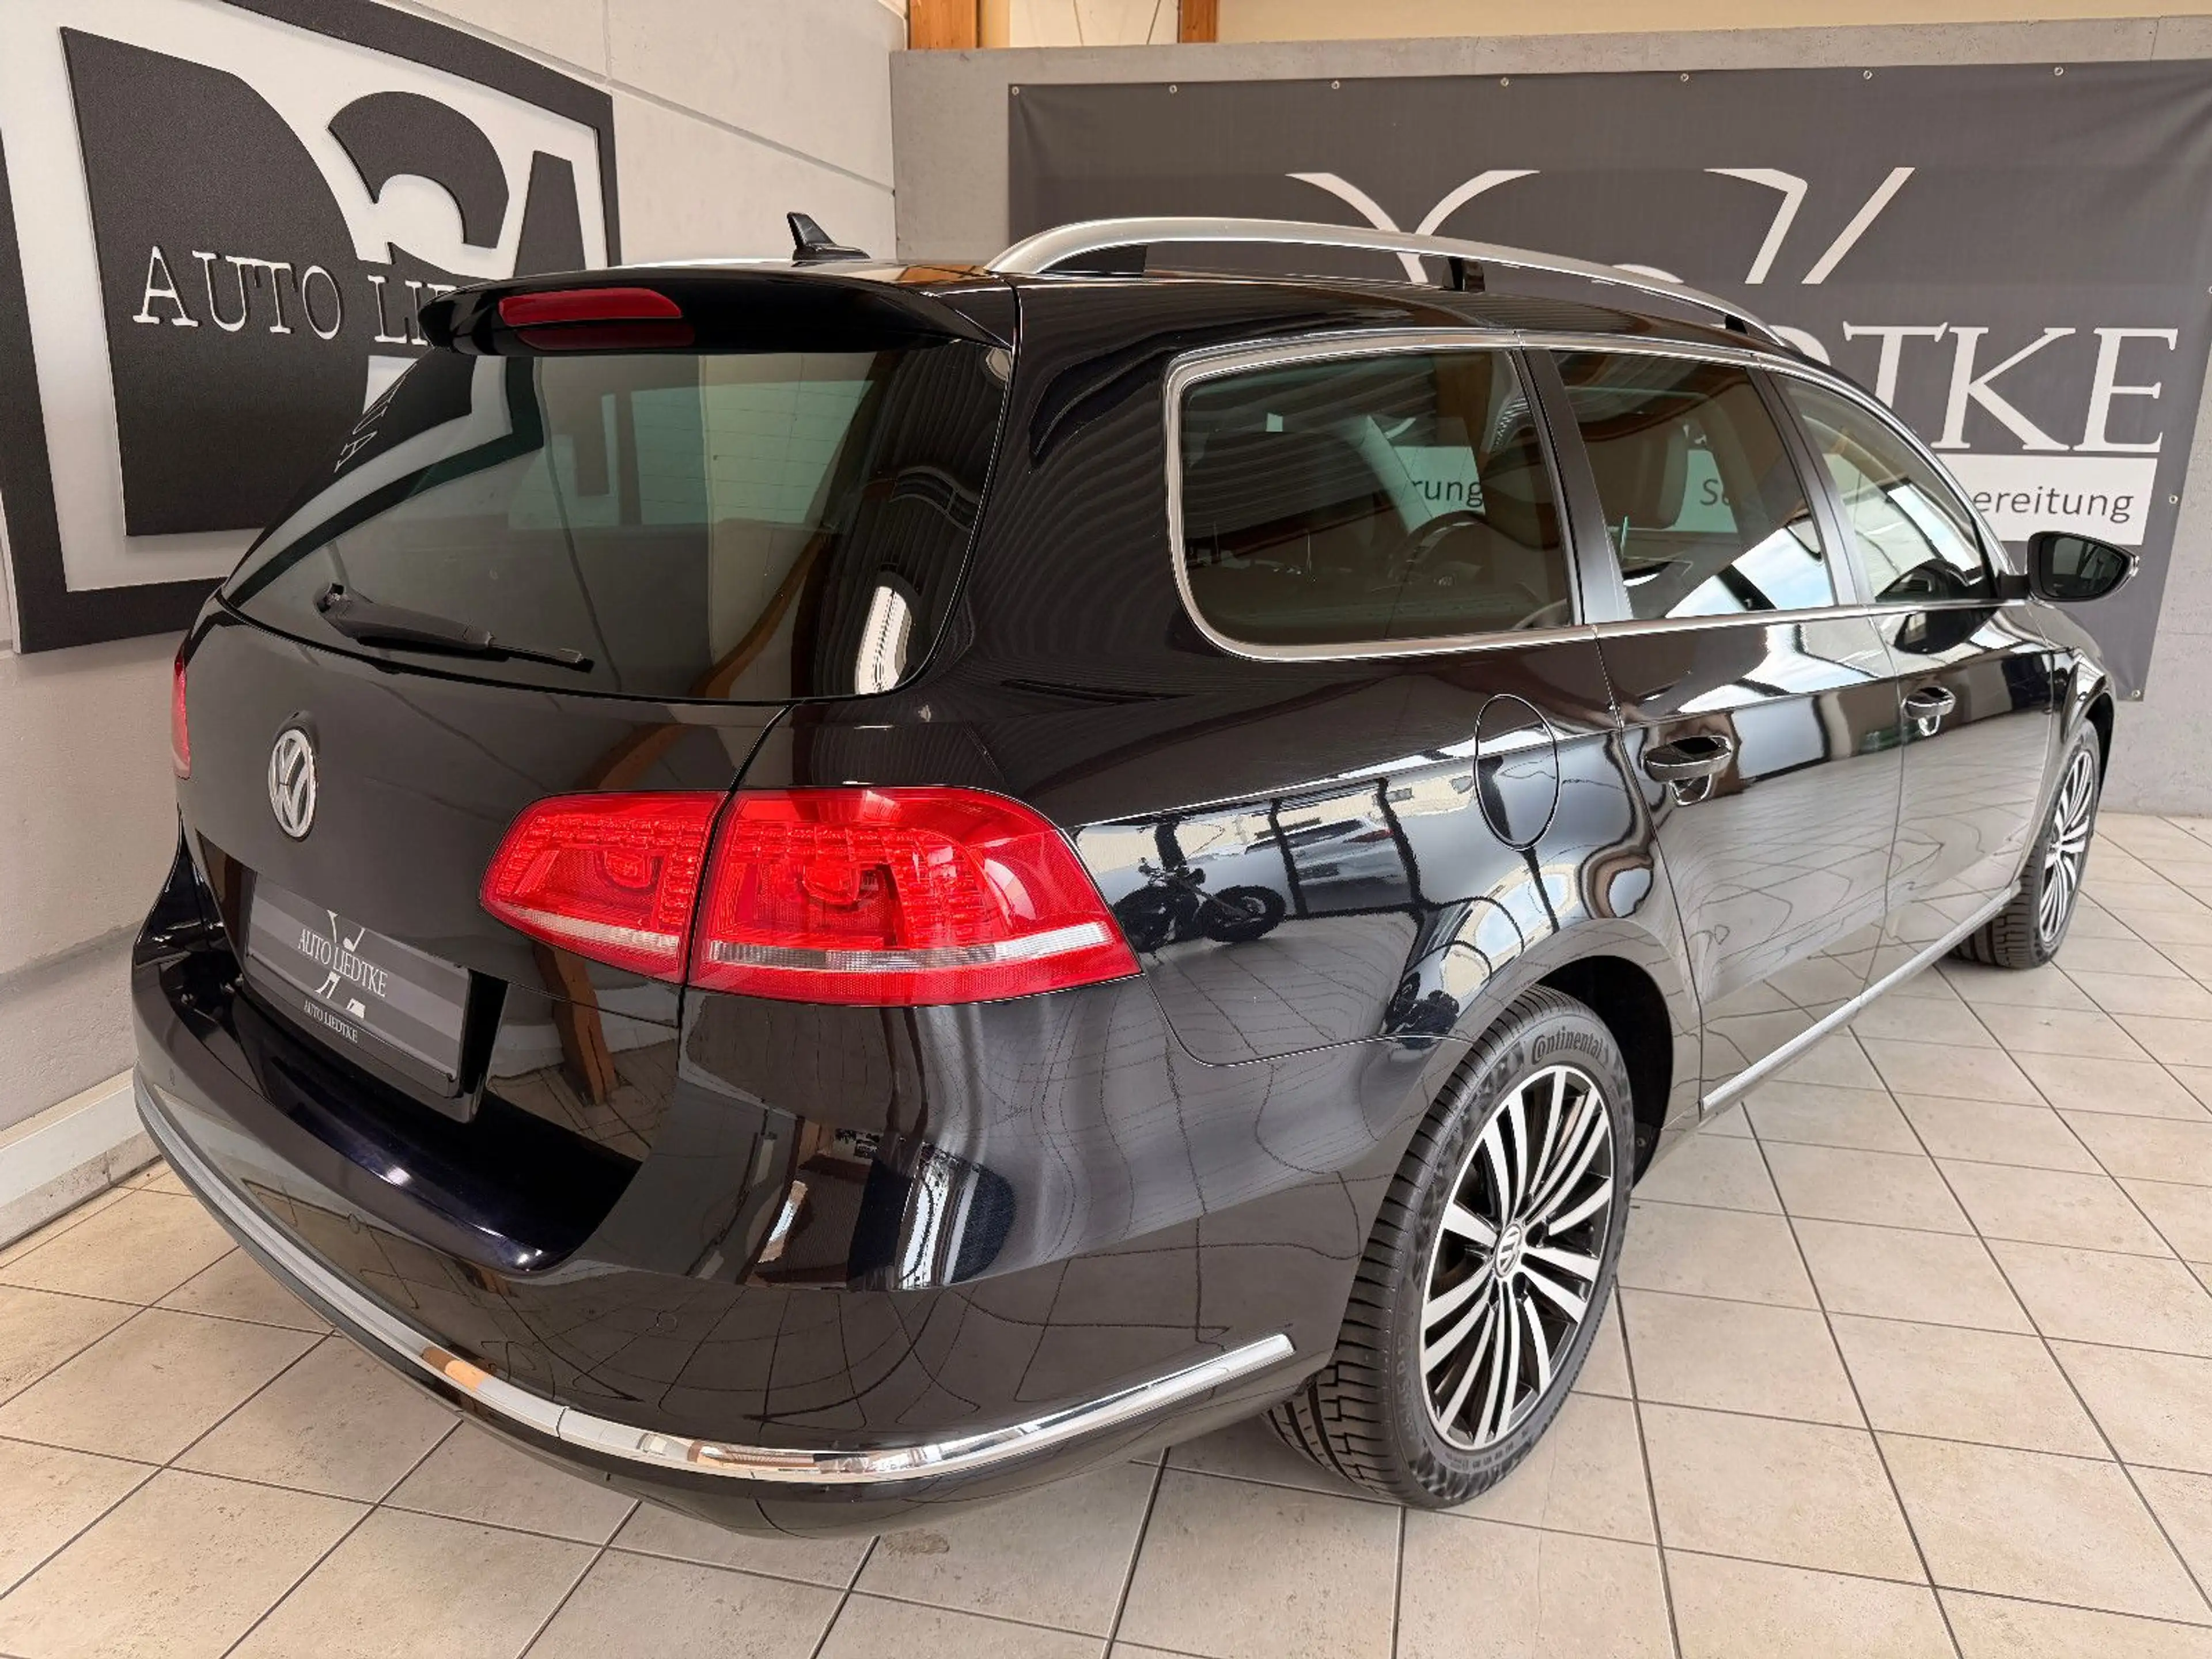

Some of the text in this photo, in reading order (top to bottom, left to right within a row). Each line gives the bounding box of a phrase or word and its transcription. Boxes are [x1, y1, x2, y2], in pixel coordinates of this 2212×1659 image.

[132, 245, 459, 346] AUTO LI
[1771, 320, 2179, 453] TKE
[298, 929, 388, 998] AUTO LIEDTKE
[1532, 1025, 1604, 1065] Continental
